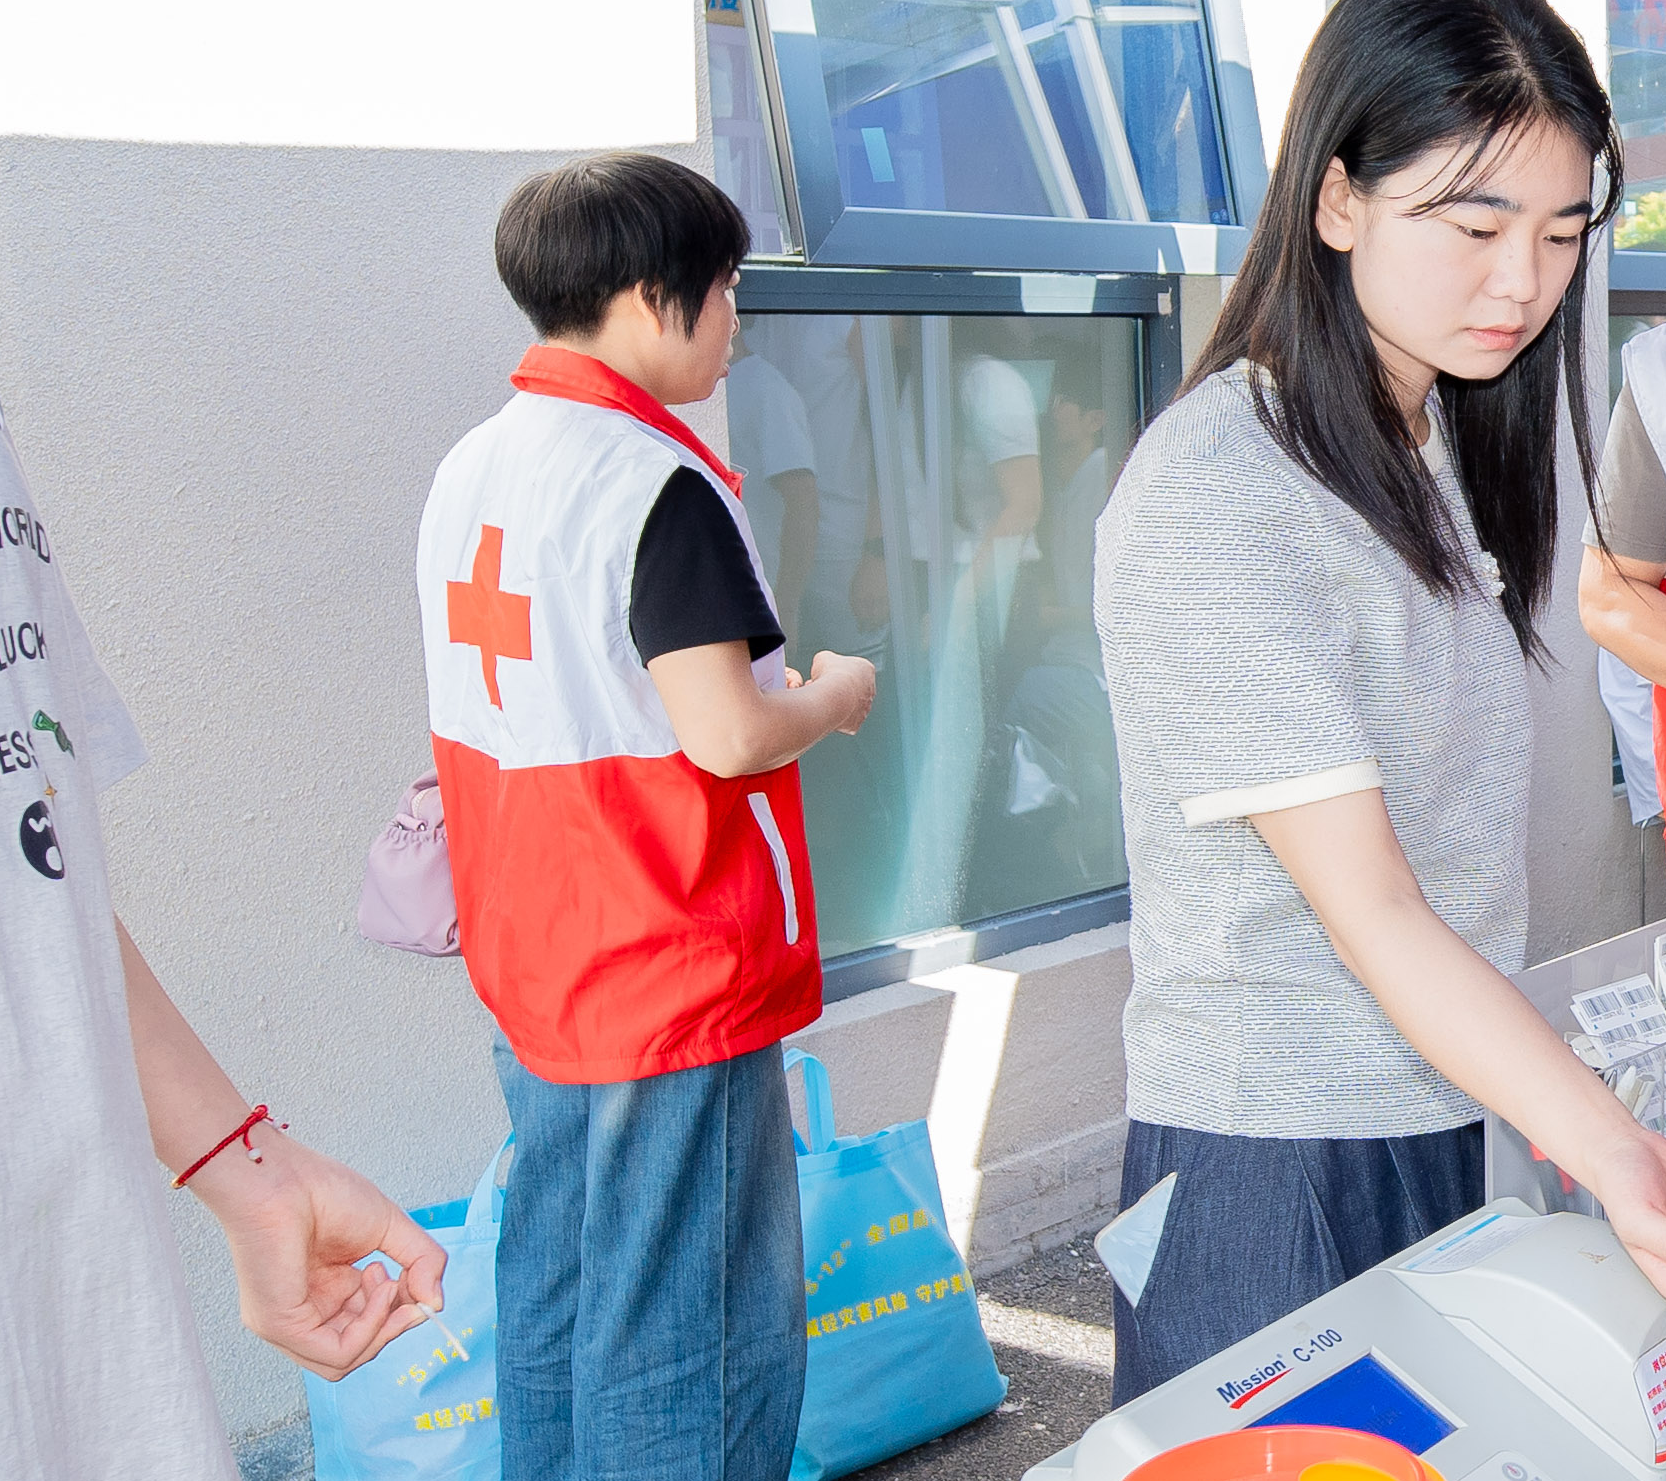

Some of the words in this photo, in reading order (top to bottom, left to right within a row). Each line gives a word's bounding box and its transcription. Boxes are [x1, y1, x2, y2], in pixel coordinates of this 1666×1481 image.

[1293, 1328, 1343, 1365] C-100
[414, 1397, 499, 1432] 减轻灾害
